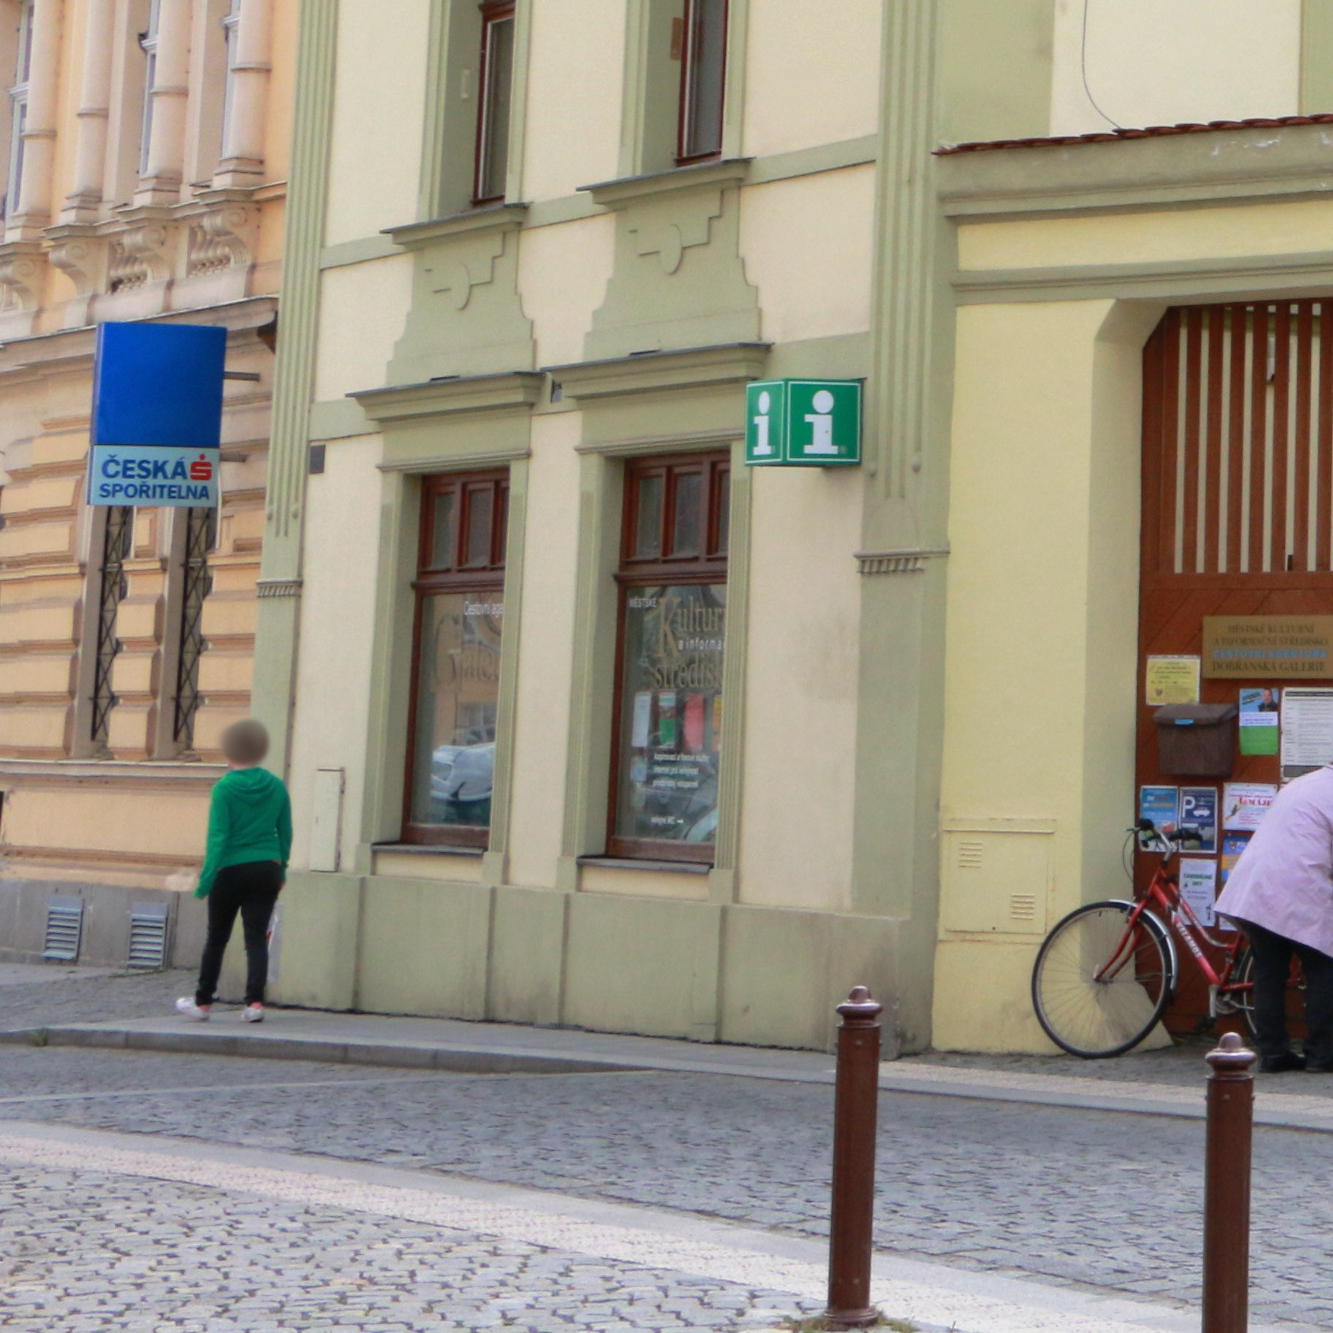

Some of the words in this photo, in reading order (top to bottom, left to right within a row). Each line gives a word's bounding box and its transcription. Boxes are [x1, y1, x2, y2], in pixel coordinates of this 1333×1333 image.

[101, 454, 188, 480] ČESKÁ
[99, 481, 210, 500] SPOŘITELNA
[1267, 622, 1315, 634] KULTURNÍ
[1279, 661, 1326, 673] GALERIE
[1182, 795, 1196, 818] P
